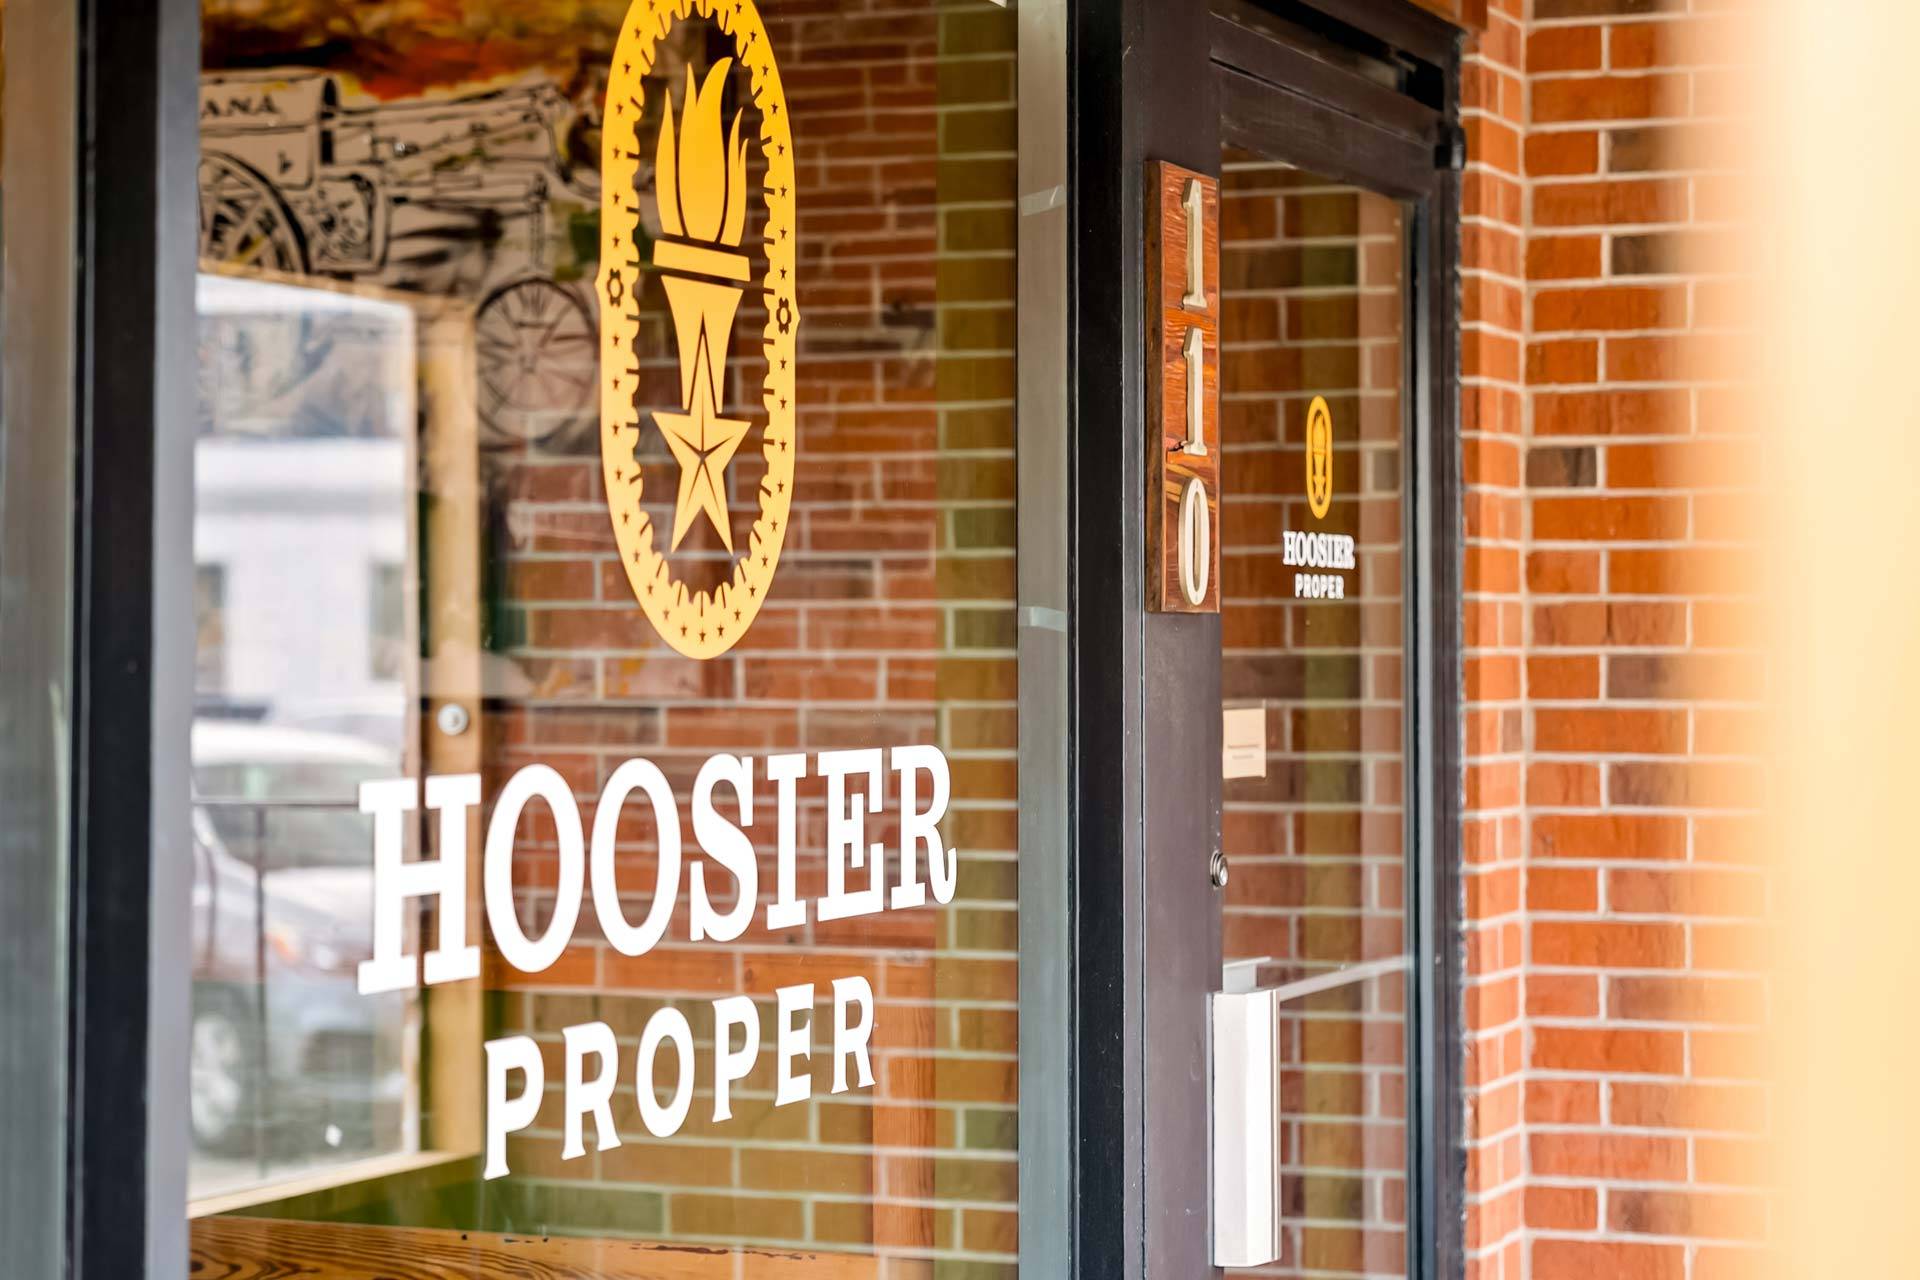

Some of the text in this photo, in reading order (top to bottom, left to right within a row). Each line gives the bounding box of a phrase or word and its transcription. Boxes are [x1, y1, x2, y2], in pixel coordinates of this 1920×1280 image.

[1179, 177, 1211, 606] 110
[1282, 530, 1355, 569] HOOSIER
[1295, 573, 1344, 600] PROPER
[358, 745, 957, 995] HOOSIER
[484, 976, 876, 1180] PROPER
